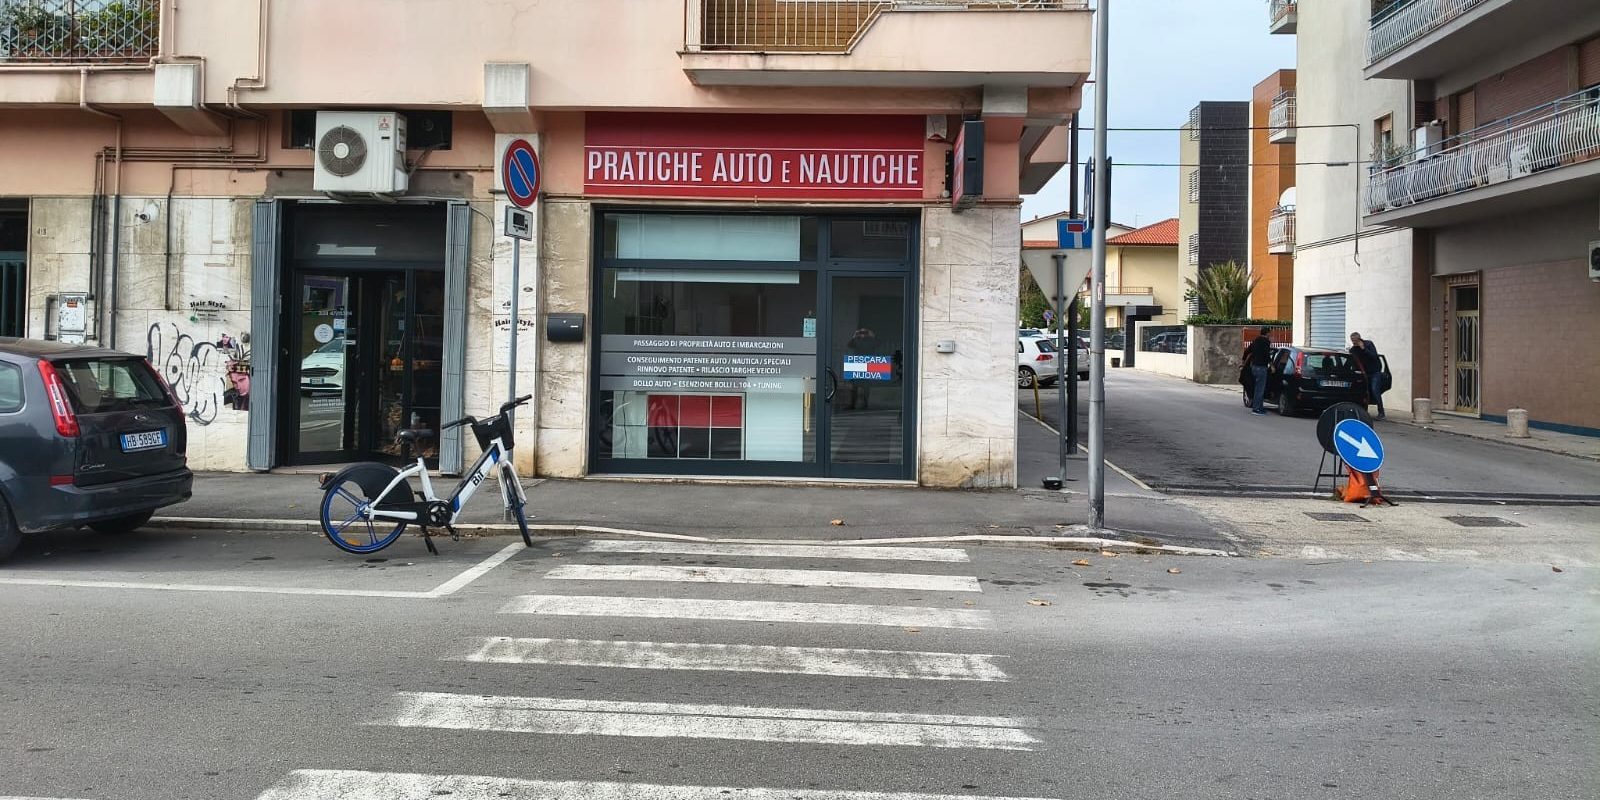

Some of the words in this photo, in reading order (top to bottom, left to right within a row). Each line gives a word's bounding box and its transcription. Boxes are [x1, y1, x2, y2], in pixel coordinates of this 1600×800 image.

[587, 151, 702, 182] PRATICHE
[712, 152, 772, 183] AUTO
[782, 160, 791, 183] E
[799, 153, 918, 184] NAUTICHE
[190, 300, 206, 308] Hair
[633, 339, 670, 347] PASSAGGIO
[679, 339, 714, 348] PROPRIETÀ
[737, 341, 784, 349] IMBARCAZIONI
[627, 356, 682, 364] CONSEGUIMENTO
[710, 357, 727, 365] AUTO
[763, 358, 791, 366] SPECIALI
[847, 355, 887, 364] PESCARA
[637, 365, 668, 373] RINNOVO
[852, 371, 882, 379] NUOVA
